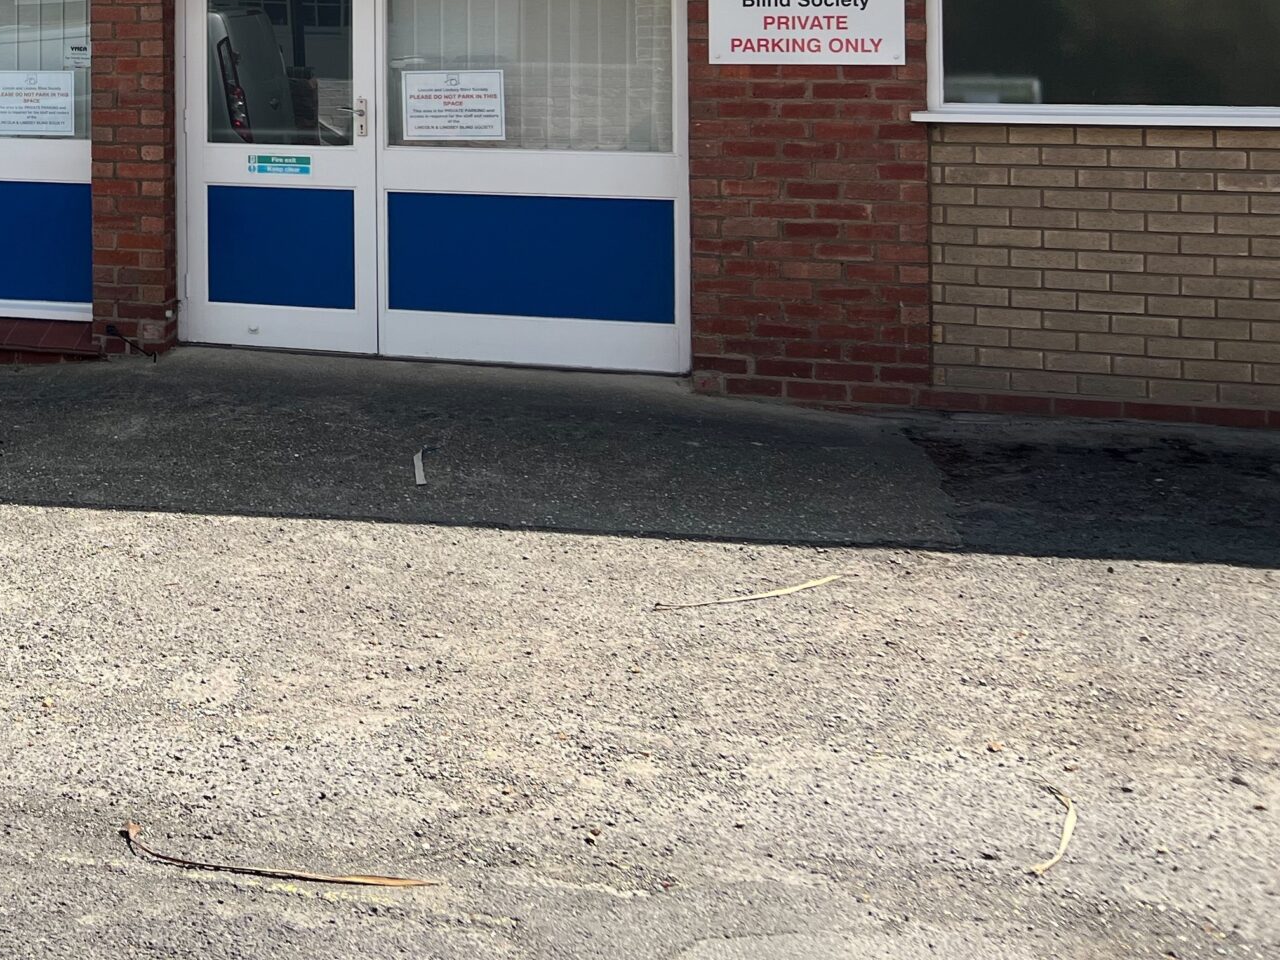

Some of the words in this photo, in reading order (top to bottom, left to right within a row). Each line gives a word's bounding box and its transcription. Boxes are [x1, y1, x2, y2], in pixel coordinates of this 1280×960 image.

[763, 15, 849, 30] PRIVATE
[730, 38, 822, 53] PARKING
[828, 38, 883, 53] ONLY
